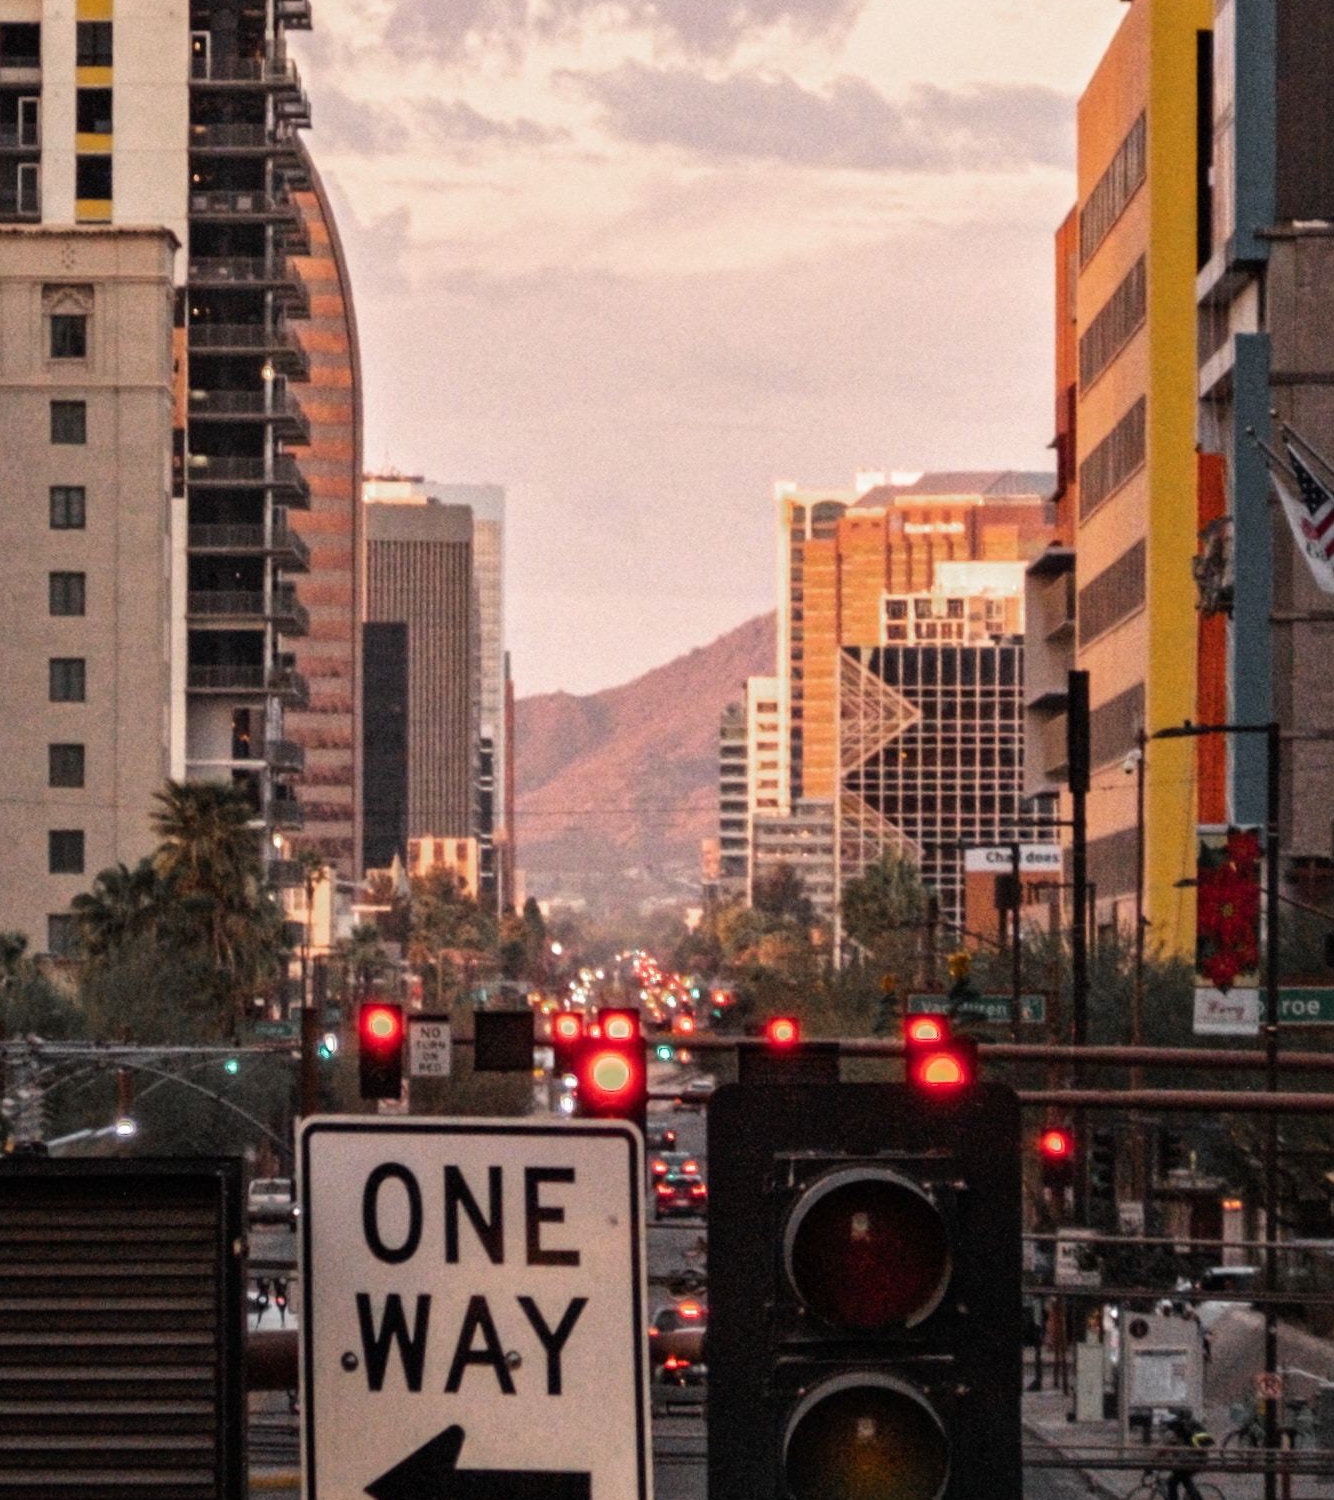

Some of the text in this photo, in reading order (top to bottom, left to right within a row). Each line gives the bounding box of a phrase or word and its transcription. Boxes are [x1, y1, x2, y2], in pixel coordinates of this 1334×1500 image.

[421, 1027, 441, 1038] NO
[362, 1162, 581, 1267] ONE
[355, 1294, 589, 1397] WAY
